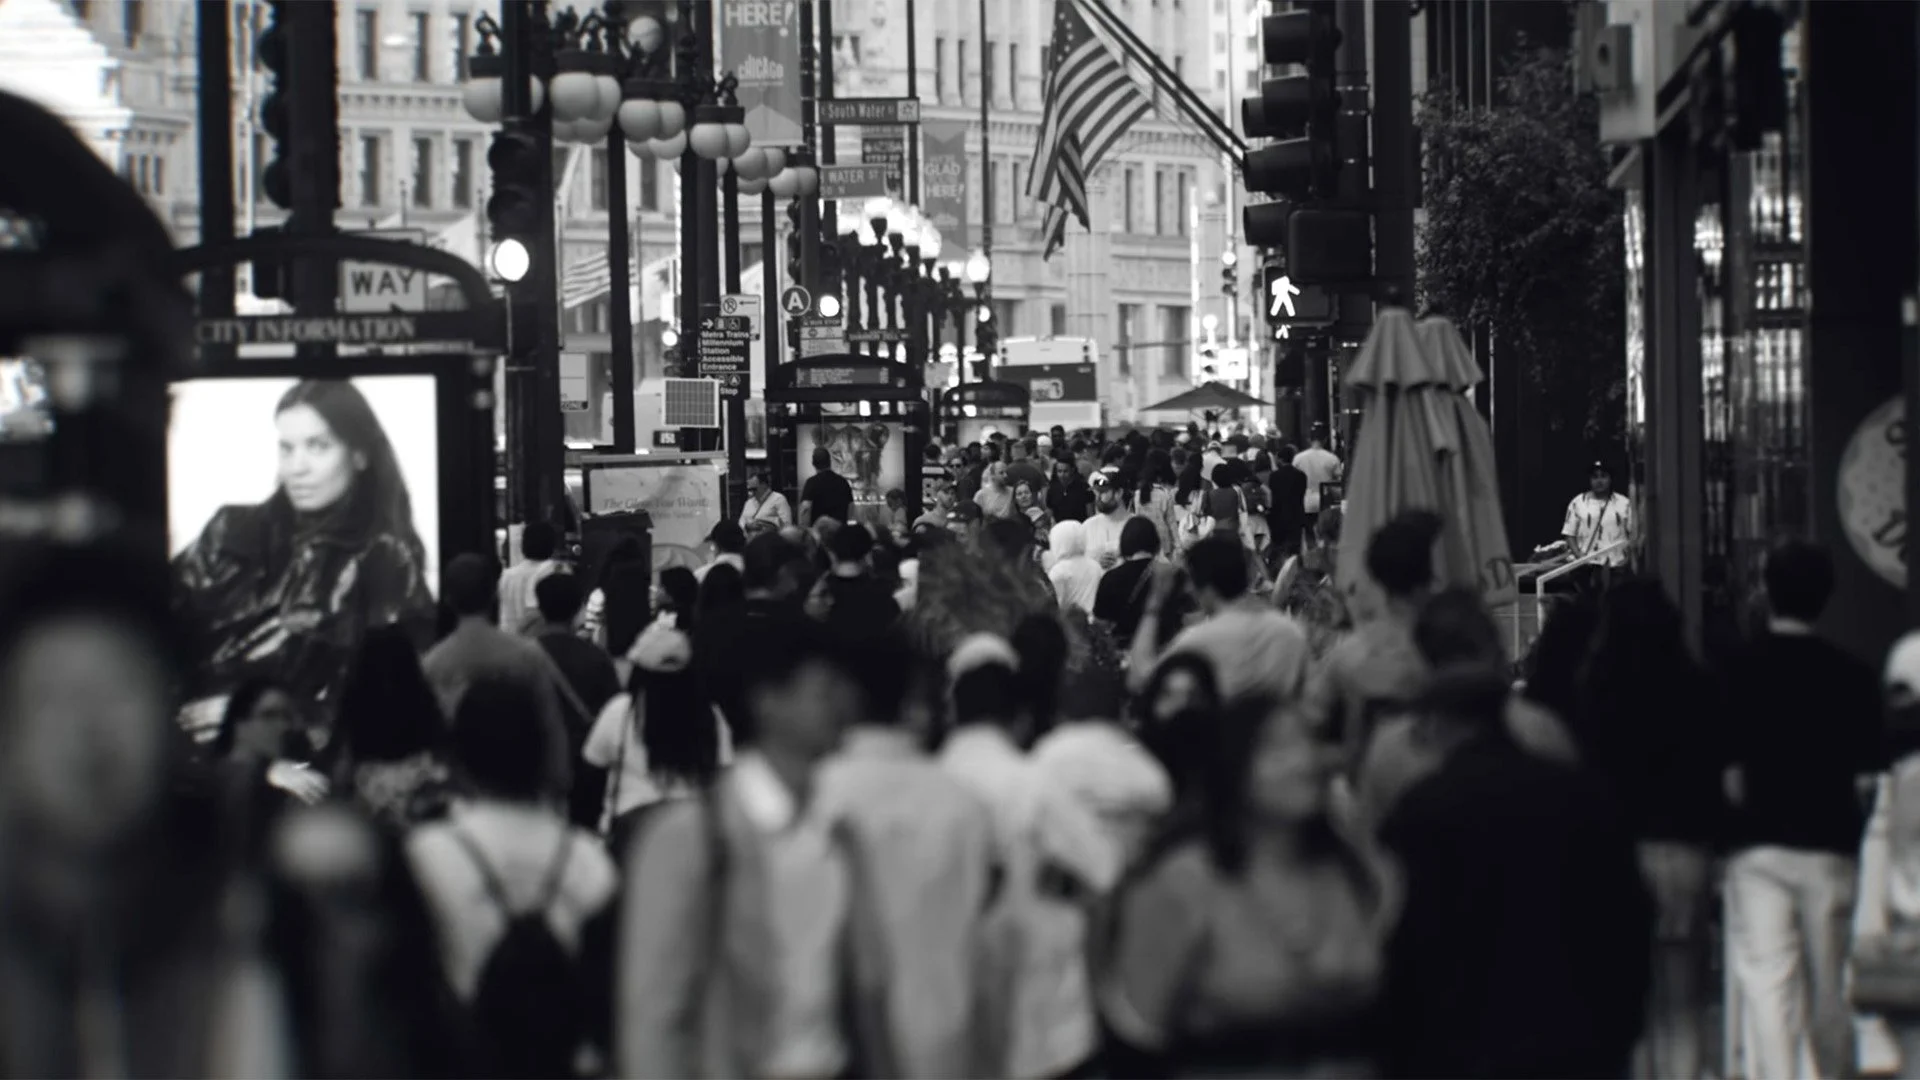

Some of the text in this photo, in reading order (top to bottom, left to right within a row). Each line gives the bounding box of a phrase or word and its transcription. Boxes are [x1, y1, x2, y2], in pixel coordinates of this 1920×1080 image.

[725, 2, 793, 38] HERE!
[828, 103, 856, 119] South
[858, 103, 885, 118] Water
[924, 162, 961, 176] GLAD
[828, 169, 865, 184] WATER
[868, 169, 879, 180] ST
[926, 183, 965, 205] HERE!
[351, 268, 415, 296] WAY
[787, 291, 804, 311] A
[196, 317, 416, 344] CITY INFORMATION
[701, 330, 750, 339] Metra Trains
[701, 339, 744, 347] Millennium
[701, 347, 731, 355] Station
[701, 355, 744, 363] Accessible
[701, 363, 737, 371] Entrance
[719, 387, 738, 396] Stop
[603, 497, 623, 510] The
